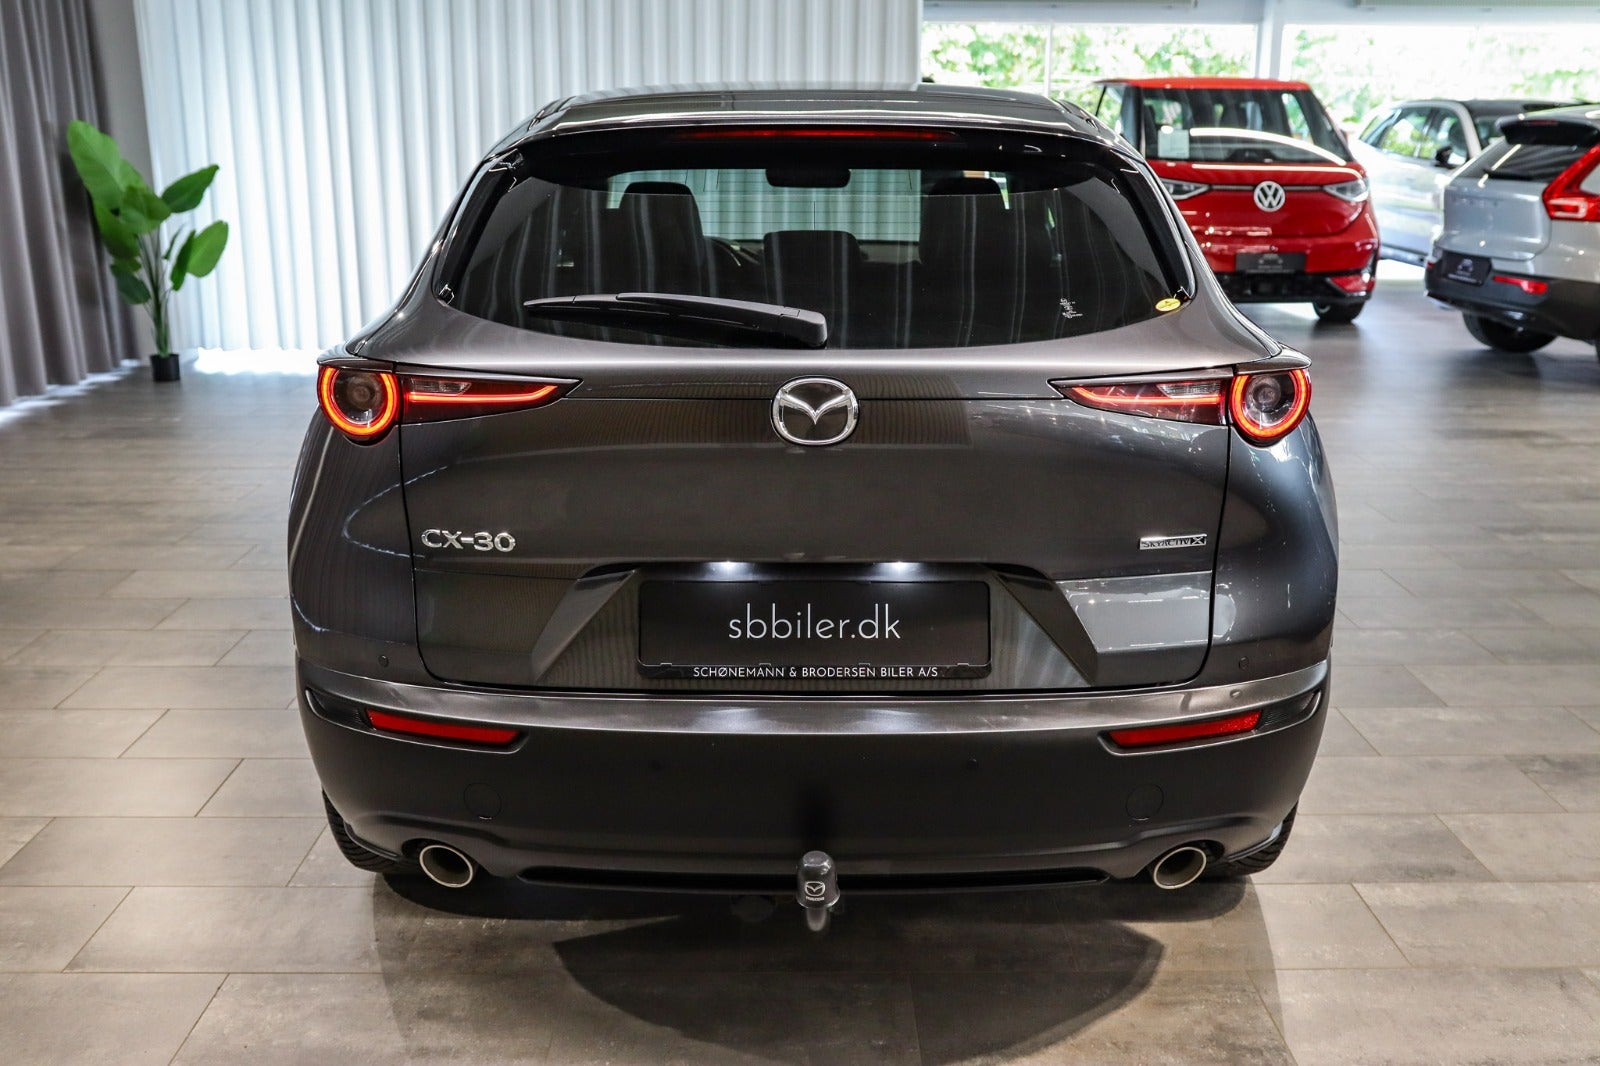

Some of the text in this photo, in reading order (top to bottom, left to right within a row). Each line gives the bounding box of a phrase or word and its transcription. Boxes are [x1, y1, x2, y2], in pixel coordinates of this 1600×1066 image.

[421, 528, 516, 552] CX-30
[728, 602, 902, 639] sbbiler.dk
[693, 666, 939, 678] SCHØNEMANN & BRODERSEN BILER A/S
